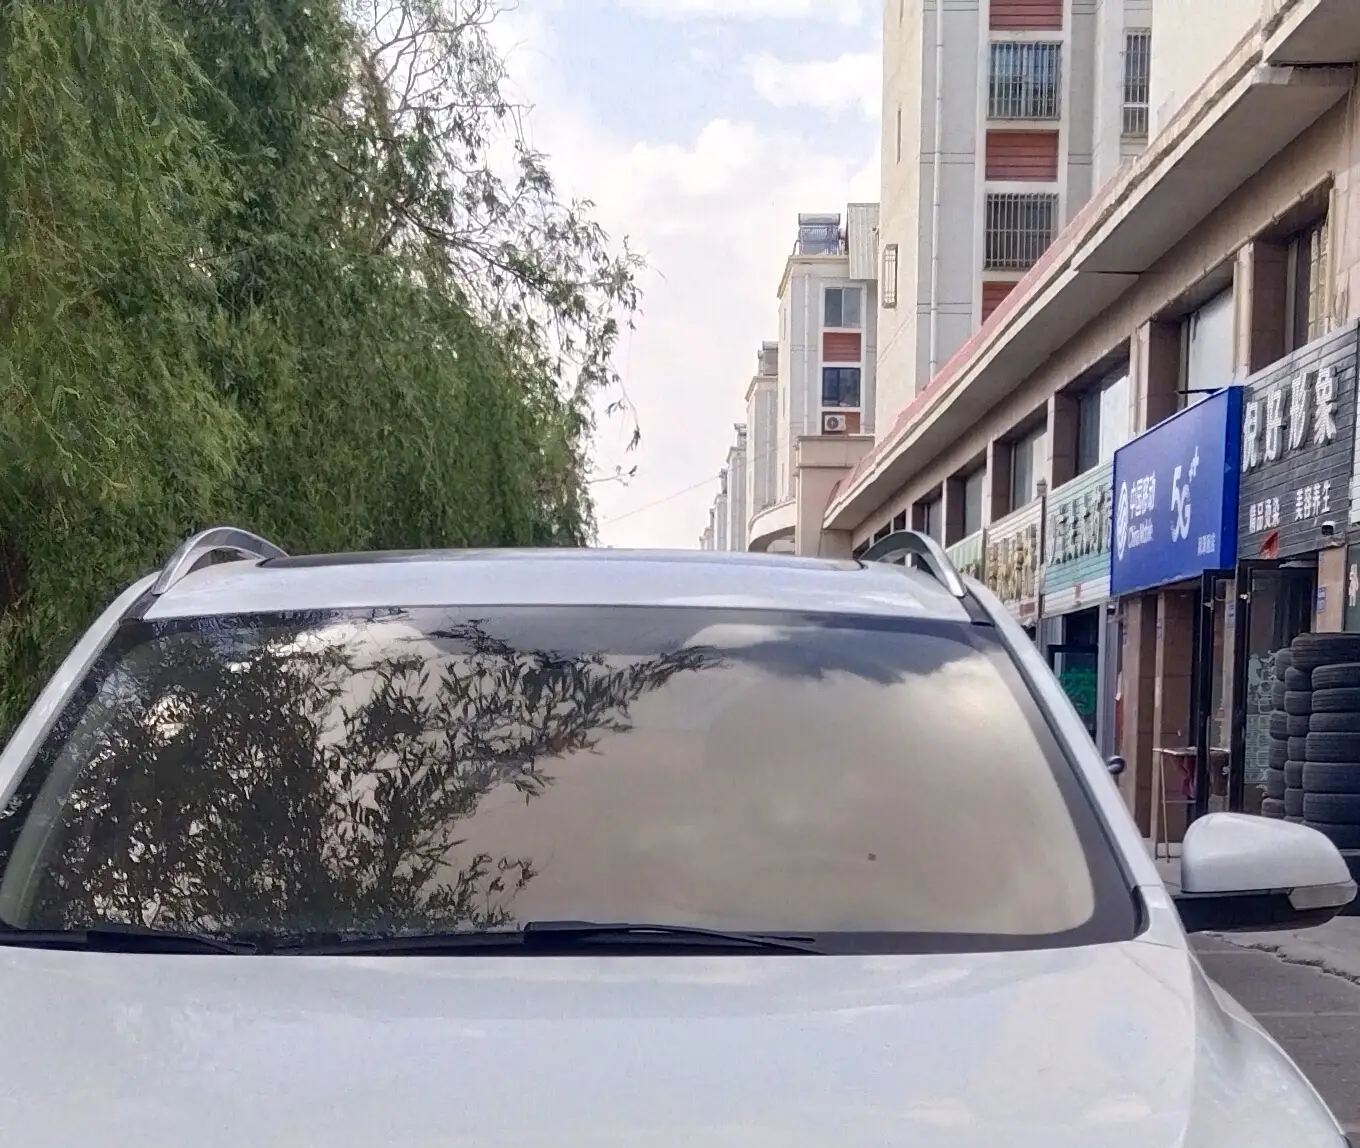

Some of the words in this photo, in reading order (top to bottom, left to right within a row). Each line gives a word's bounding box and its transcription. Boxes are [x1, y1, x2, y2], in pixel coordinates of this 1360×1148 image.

[1130, 471, 1156, 520] 中国移动
[1295, 479, 1331, 521] 美容养生
